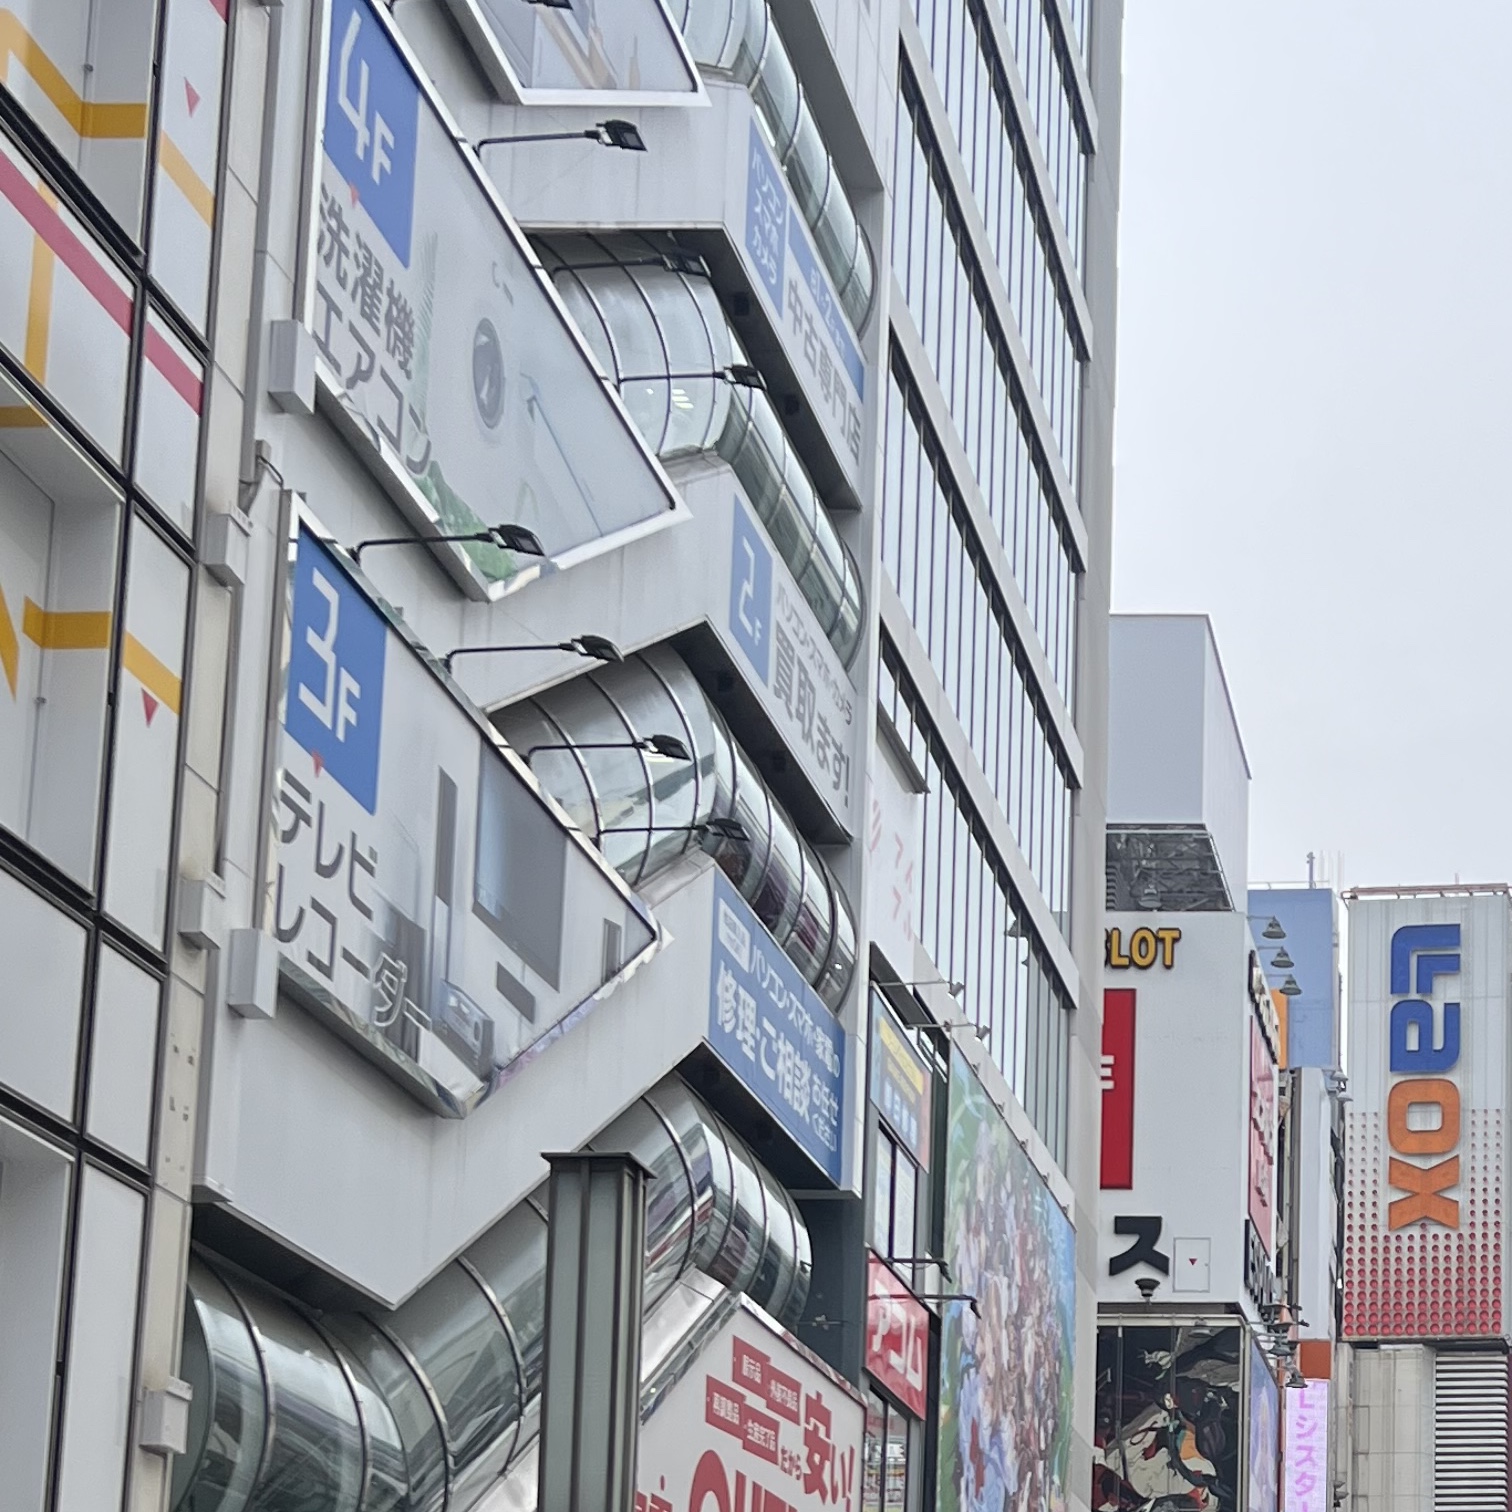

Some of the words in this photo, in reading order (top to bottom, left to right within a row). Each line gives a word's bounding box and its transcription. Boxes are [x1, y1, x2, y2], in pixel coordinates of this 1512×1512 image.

[335, 4, 394, 188] 4F
[317, 181, 415, 381] 洗濯機
[312, 280, 432, 475] エアコン
[787, 276, 862, 467] 中古専門店
[297, 567, 362, 742] 3F
[738, 534, 764, 647] 2F
[274, 769, 377, 921] テレビ
[1105, 927, 1182, 970] LOT
[869, 1281, 924, 1383] アコム
